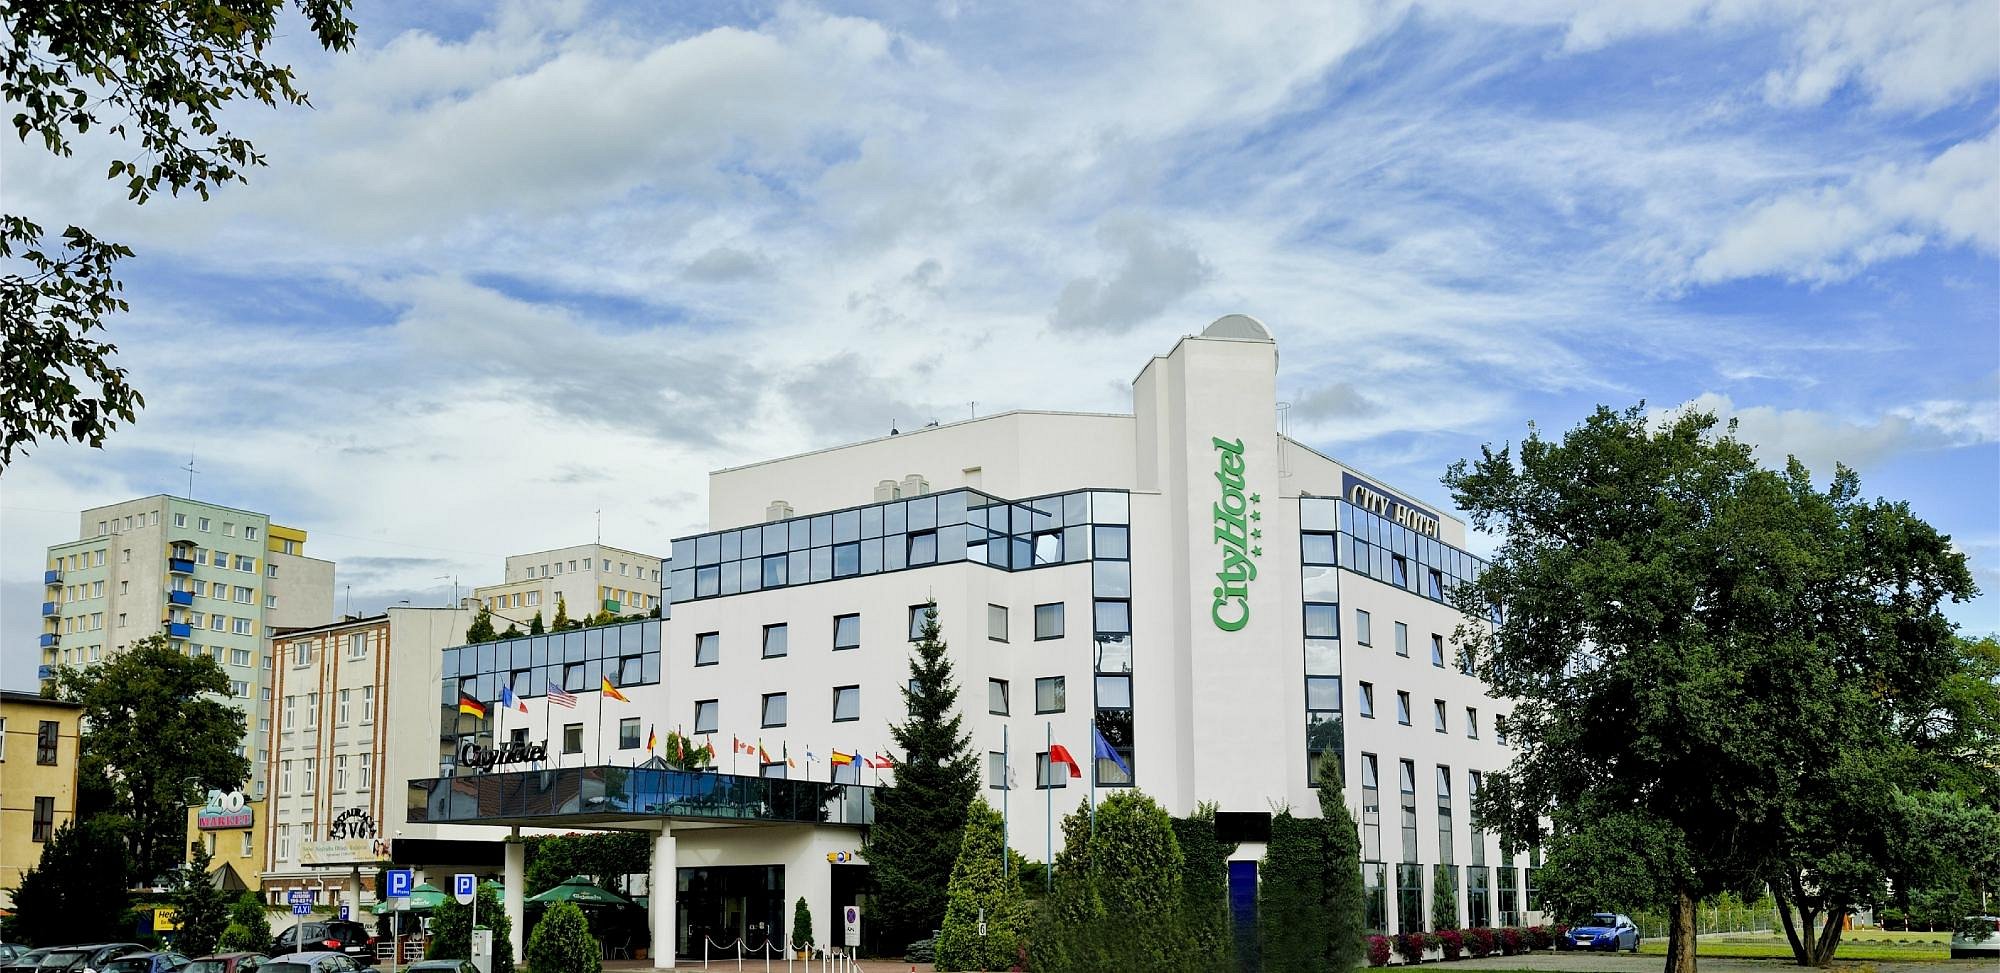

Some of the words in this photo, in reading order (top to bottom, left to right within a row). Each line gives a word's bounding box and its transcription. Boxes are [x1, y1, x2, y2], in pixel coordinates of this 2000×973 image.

[1349, 484, 1391, 516] CITY
[1393, 502, 1440, 539] HOTEL
[1212, 436, 1258, 632] CityHotel
[206, 788, 244, 815] ZOO
[199, 814, 250, 827] MARKET
[393, 873, 407, 894] P
[460, 878, 470, 893] P
[293, 905, 310, 914] TAXI
[341, 906, 348, 919] P
